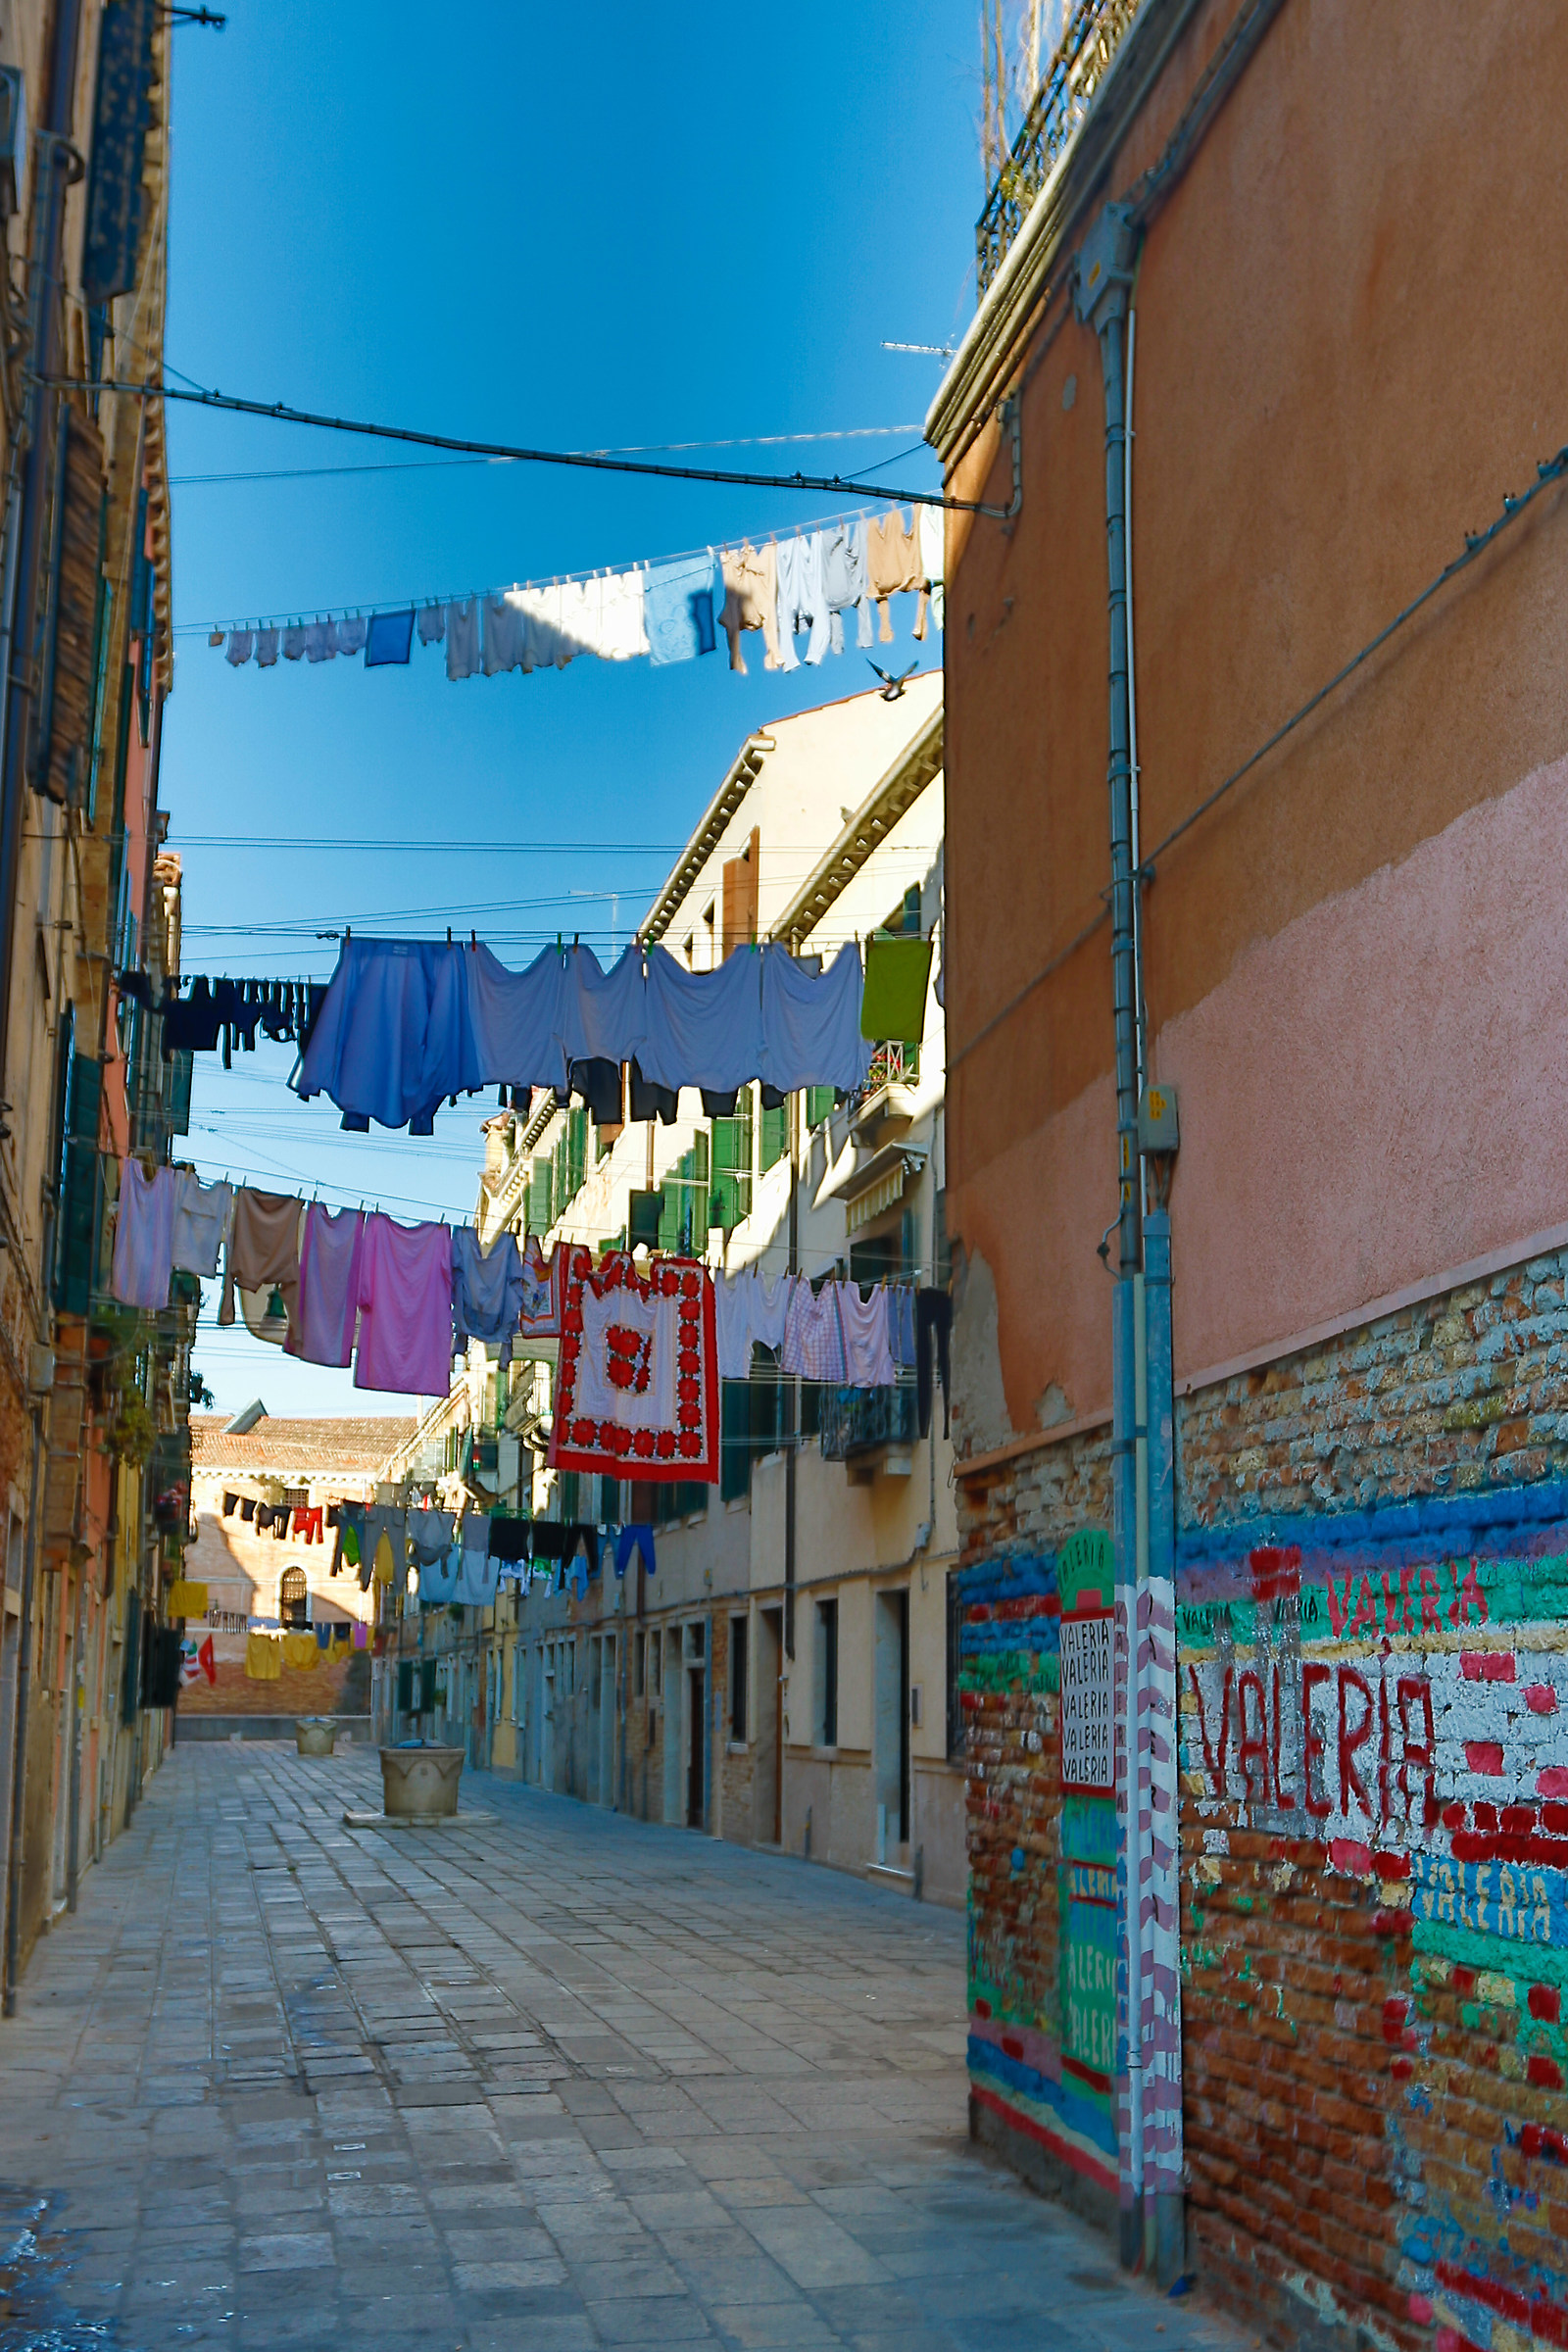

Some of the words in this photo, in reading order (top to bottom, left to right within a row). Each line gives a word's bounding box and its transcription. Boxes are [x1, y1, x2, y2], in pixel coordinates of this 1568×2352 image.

[1326, 1558, 1489, 1639] VALERIA
[1060, 1619, 1109, 1652] VALERIA
[1062, 1649, 1108, 1687] VALERIA
[1062, 1690, 1108, 1720] VALERIA
[1063, 1724, 1108, 1752] VALERIA
[1189, 1663, 1437, 1832] VALERIA
[1063, 1755, 1107, 1783] VALERIA
[1415, 1855, 1548, 1909] VALERIA
[1421, 1887, 1551, 1941] VALERIA
